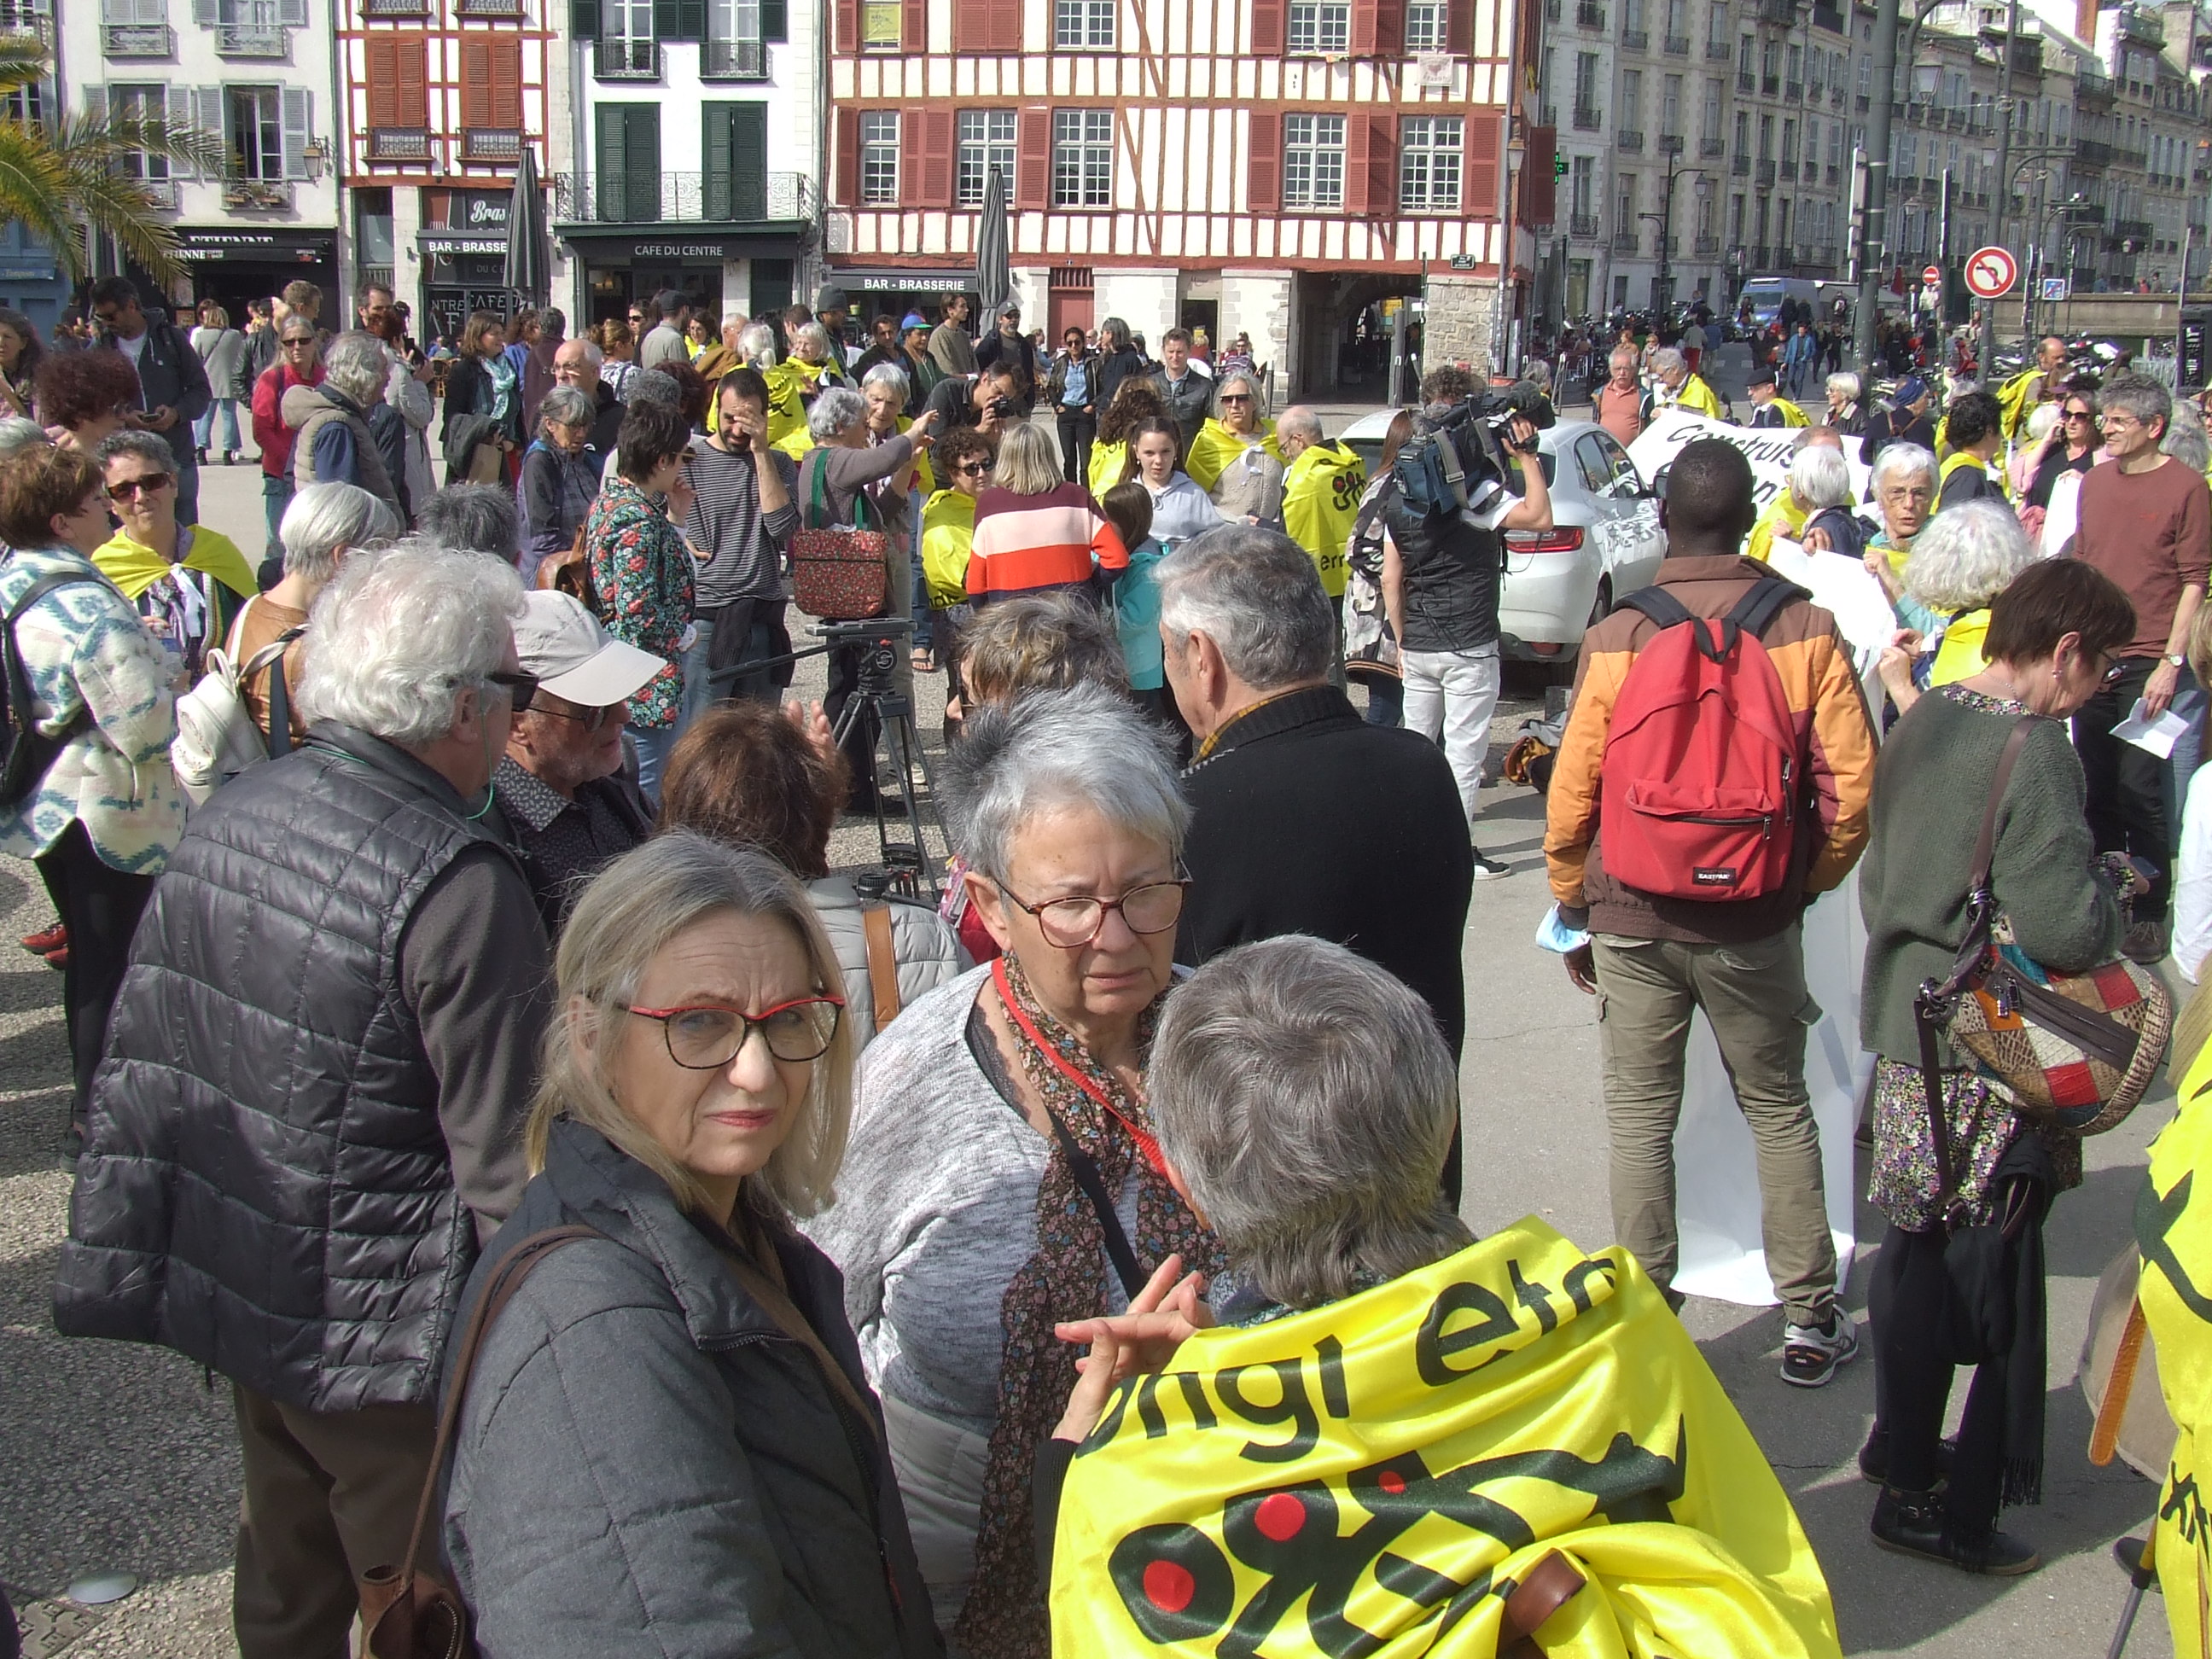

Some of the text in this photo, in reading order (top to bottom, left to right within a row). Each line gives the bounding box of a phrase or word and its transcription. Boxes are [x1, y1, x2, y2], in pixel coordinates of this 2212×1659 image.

[428, 242, 452, 252] BAR
[634, 246, 724, 256] CAFE DU CENTRE
[864, 278, 888, 289] BAR
[899, 279, 965, 290] BRASSERIE
